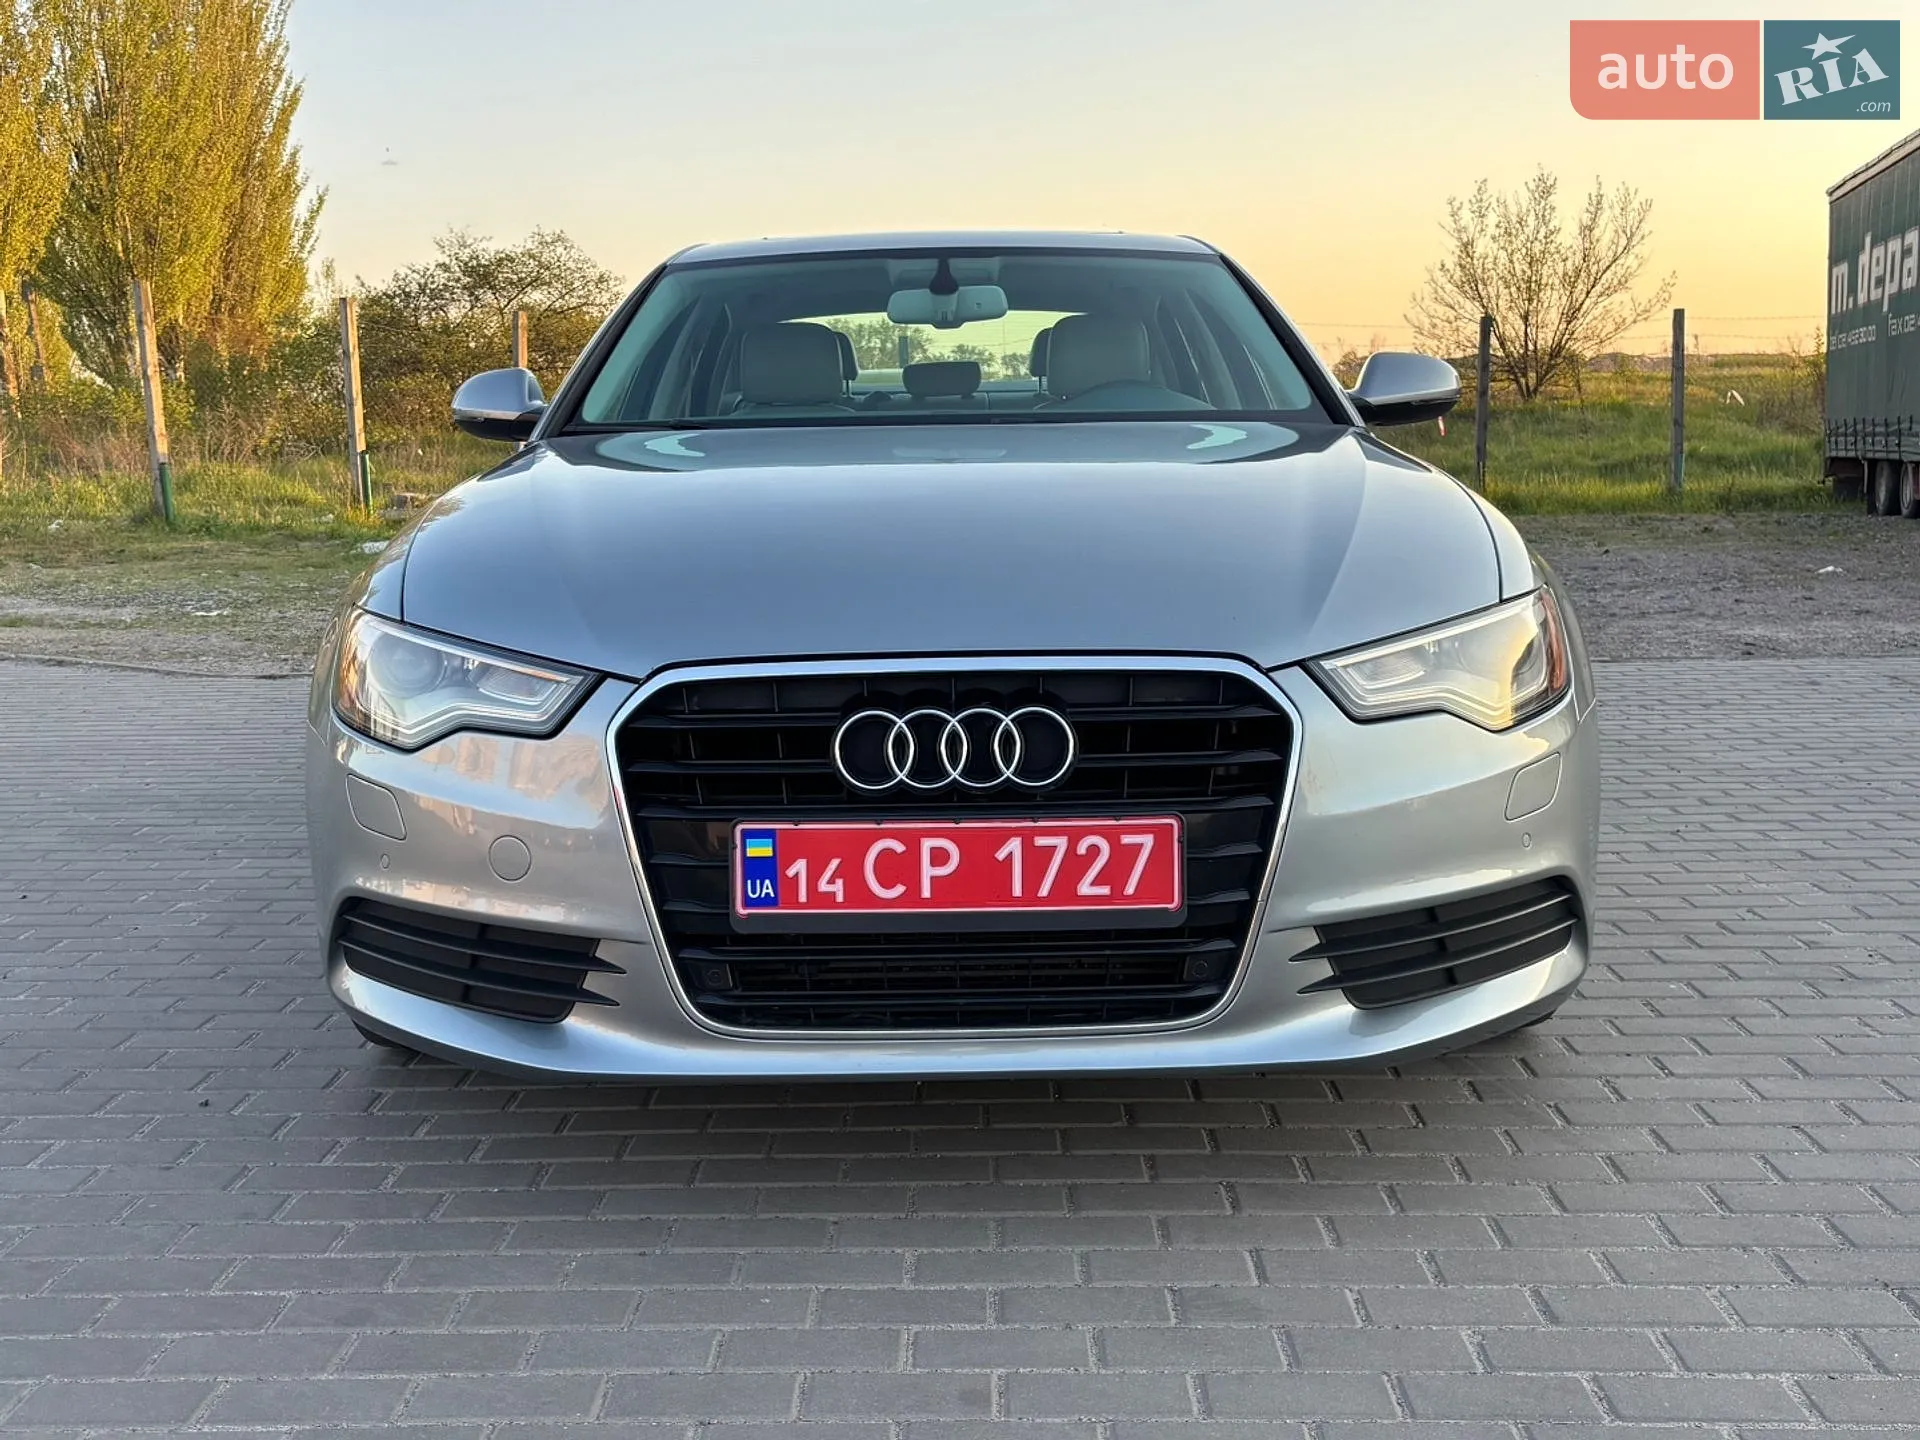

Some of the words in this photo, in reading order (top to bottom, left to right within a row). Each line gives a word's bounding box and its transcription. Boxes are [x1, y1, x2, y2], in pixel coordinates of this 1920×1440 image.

[747, 878, 776, 898] UA
[785, 857, 845, 902] 14
[863, 837, 960, 899] CP
[994, 833, 1155, 898] 1727
